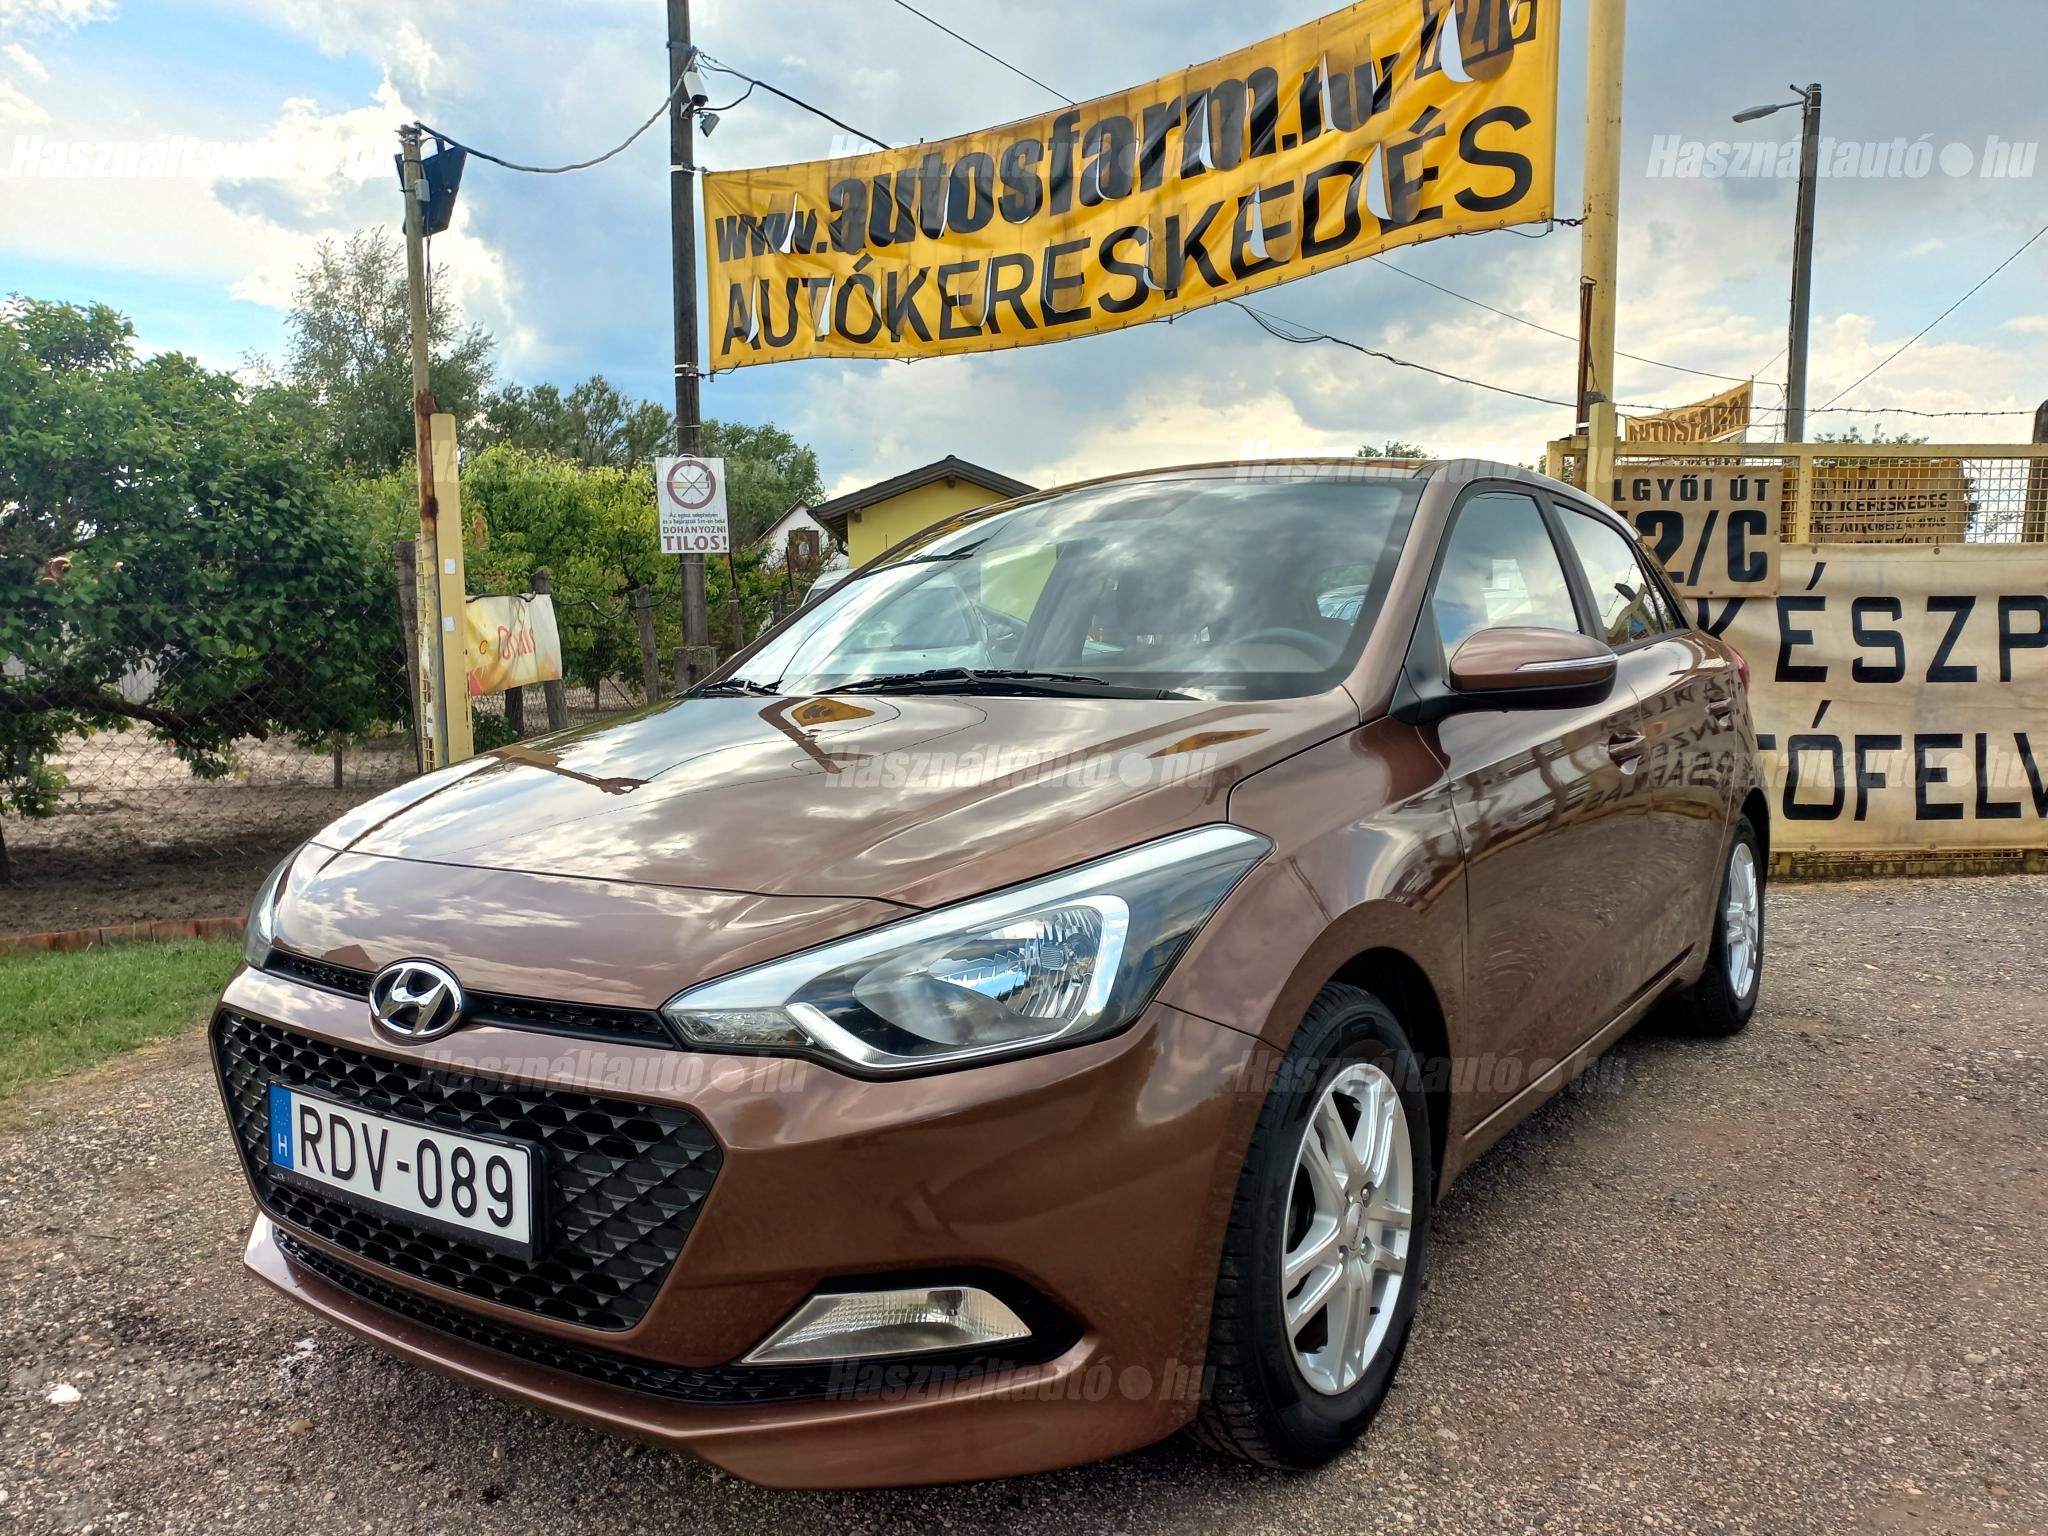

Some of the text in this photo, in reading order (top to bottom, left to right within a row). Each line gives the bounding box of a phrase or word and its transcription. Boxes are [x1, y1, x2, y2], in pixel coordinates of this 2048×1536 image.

[721, 105, 1532, 355] AUTÓKERESKEDÉS
[1730, 475, 1770, 501] ÚT
[663, 535, 728, 551] TILOS!
[1616, 510, 1768, 586] 2/C
[278, 1133, 288, 1157] H
[299, 1103, 514, 1228] RDV-089
